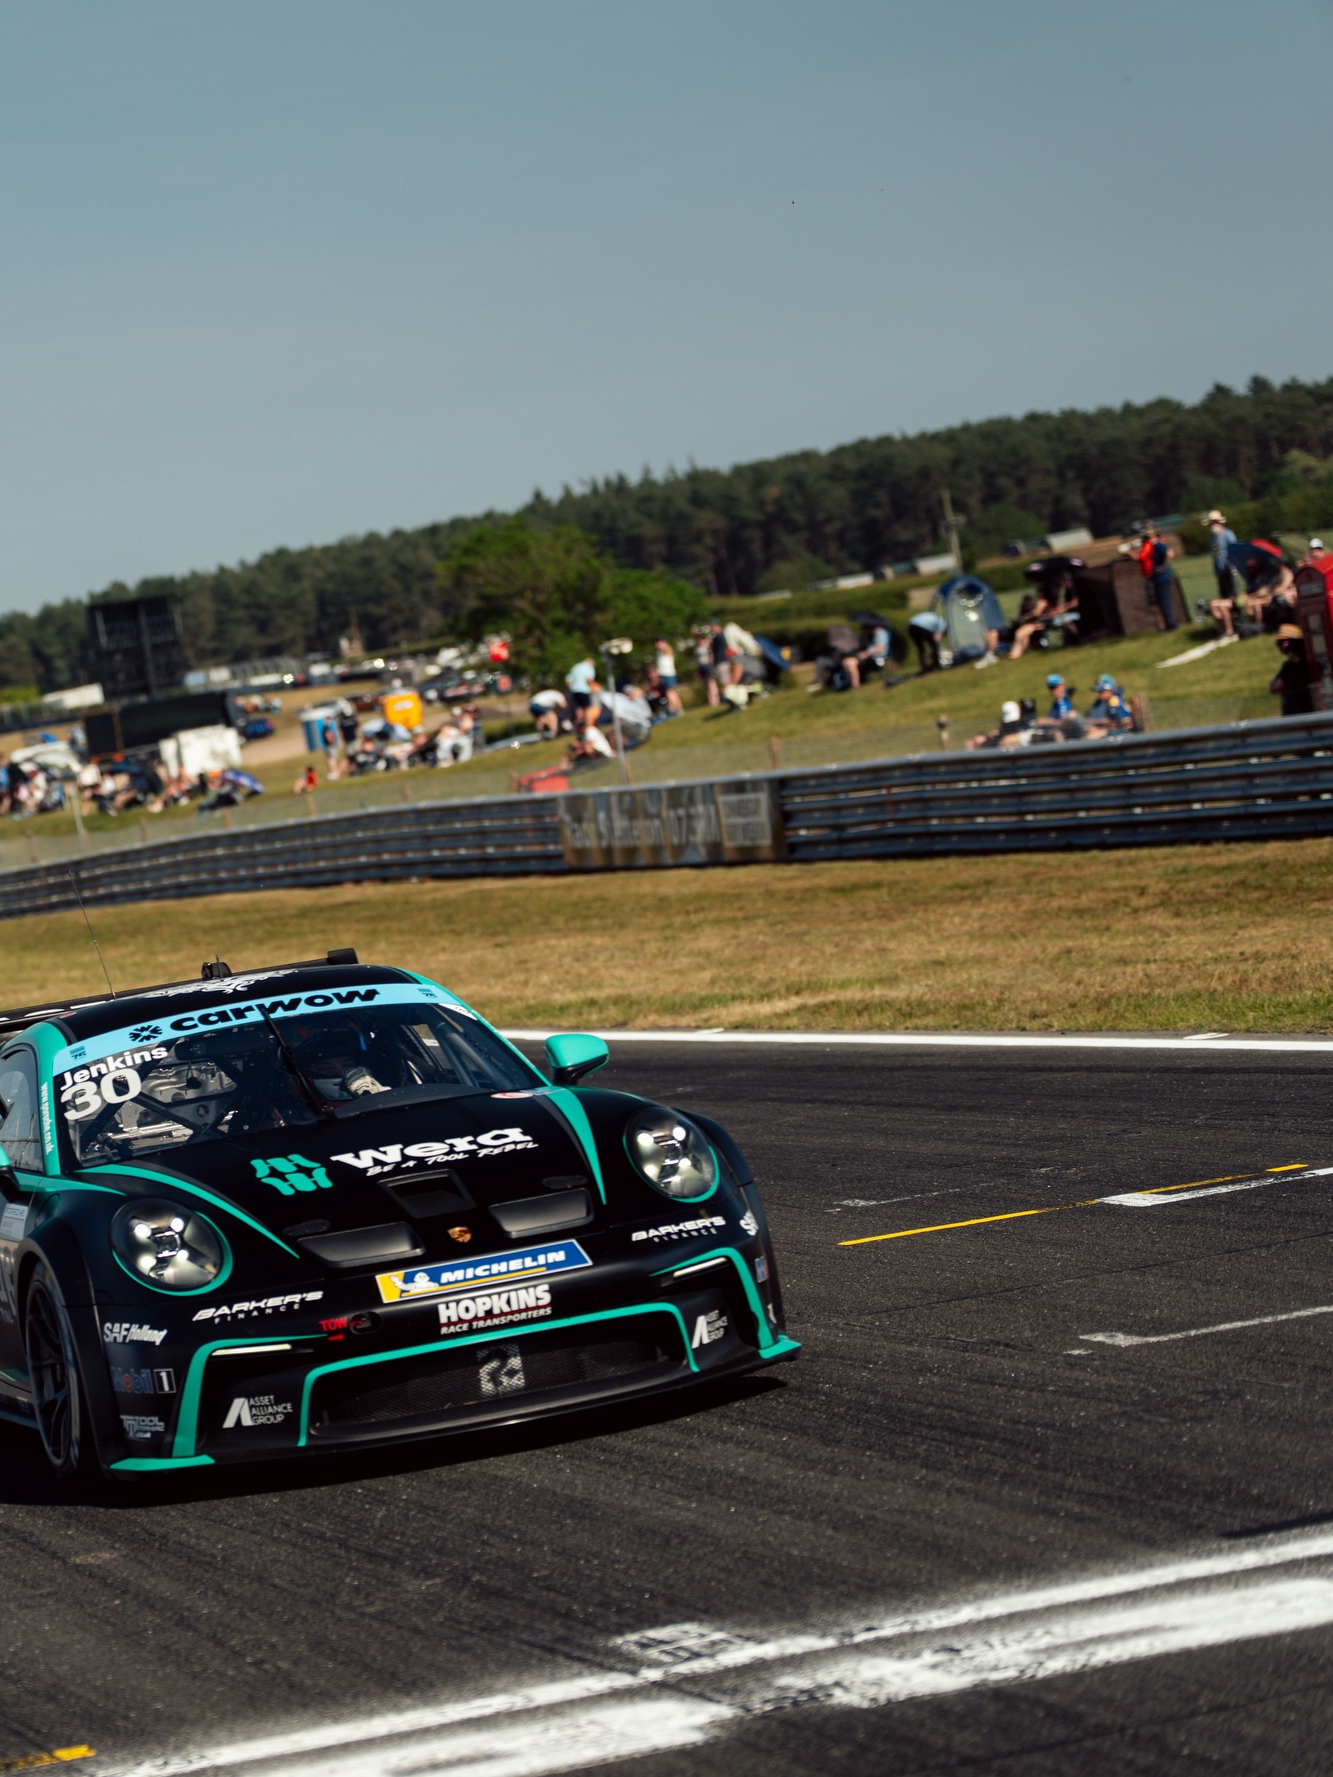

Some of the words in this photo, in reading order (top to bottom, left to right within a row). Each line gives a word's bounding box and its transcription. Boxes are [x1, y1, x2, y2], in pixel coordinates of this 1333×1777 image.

[170, 988, 381, 1031] carwow
[60, 1046, 169, 1091] Jenkins
[60, 1068, 142, 1120] 30
[366, 1163, 396, 1177] BE
[400, 1160, 417, 1169] A
[424, 1152, 470, 1165] TOOL
[476, 1141, 539, 1158] REBEL
[631, 1215, 727, 1242] BARKER'S
[652, 1227, 718, 1243] FINANCE
[440, 1250, 567, 1284] MICHELIN
[192, 1290, 324, 1321] BARKER'S
[214, 1303, 300, 1324] FINANCE
[437, 1283, 552, 1324] HOPKINS
[319, 1316, 348, 1332] TOW
[440, 1323, 469, 1335] RACE
[472, 1306, 552, 1330] TRANSPORTERS
[110, 1366, 154, 1394] Mobil
[249, 1395, 275, 1406] ASSET
[251, 1403, 293, 1415] ALLIANCE
[252, 1414, 285, 1425] GROUP
